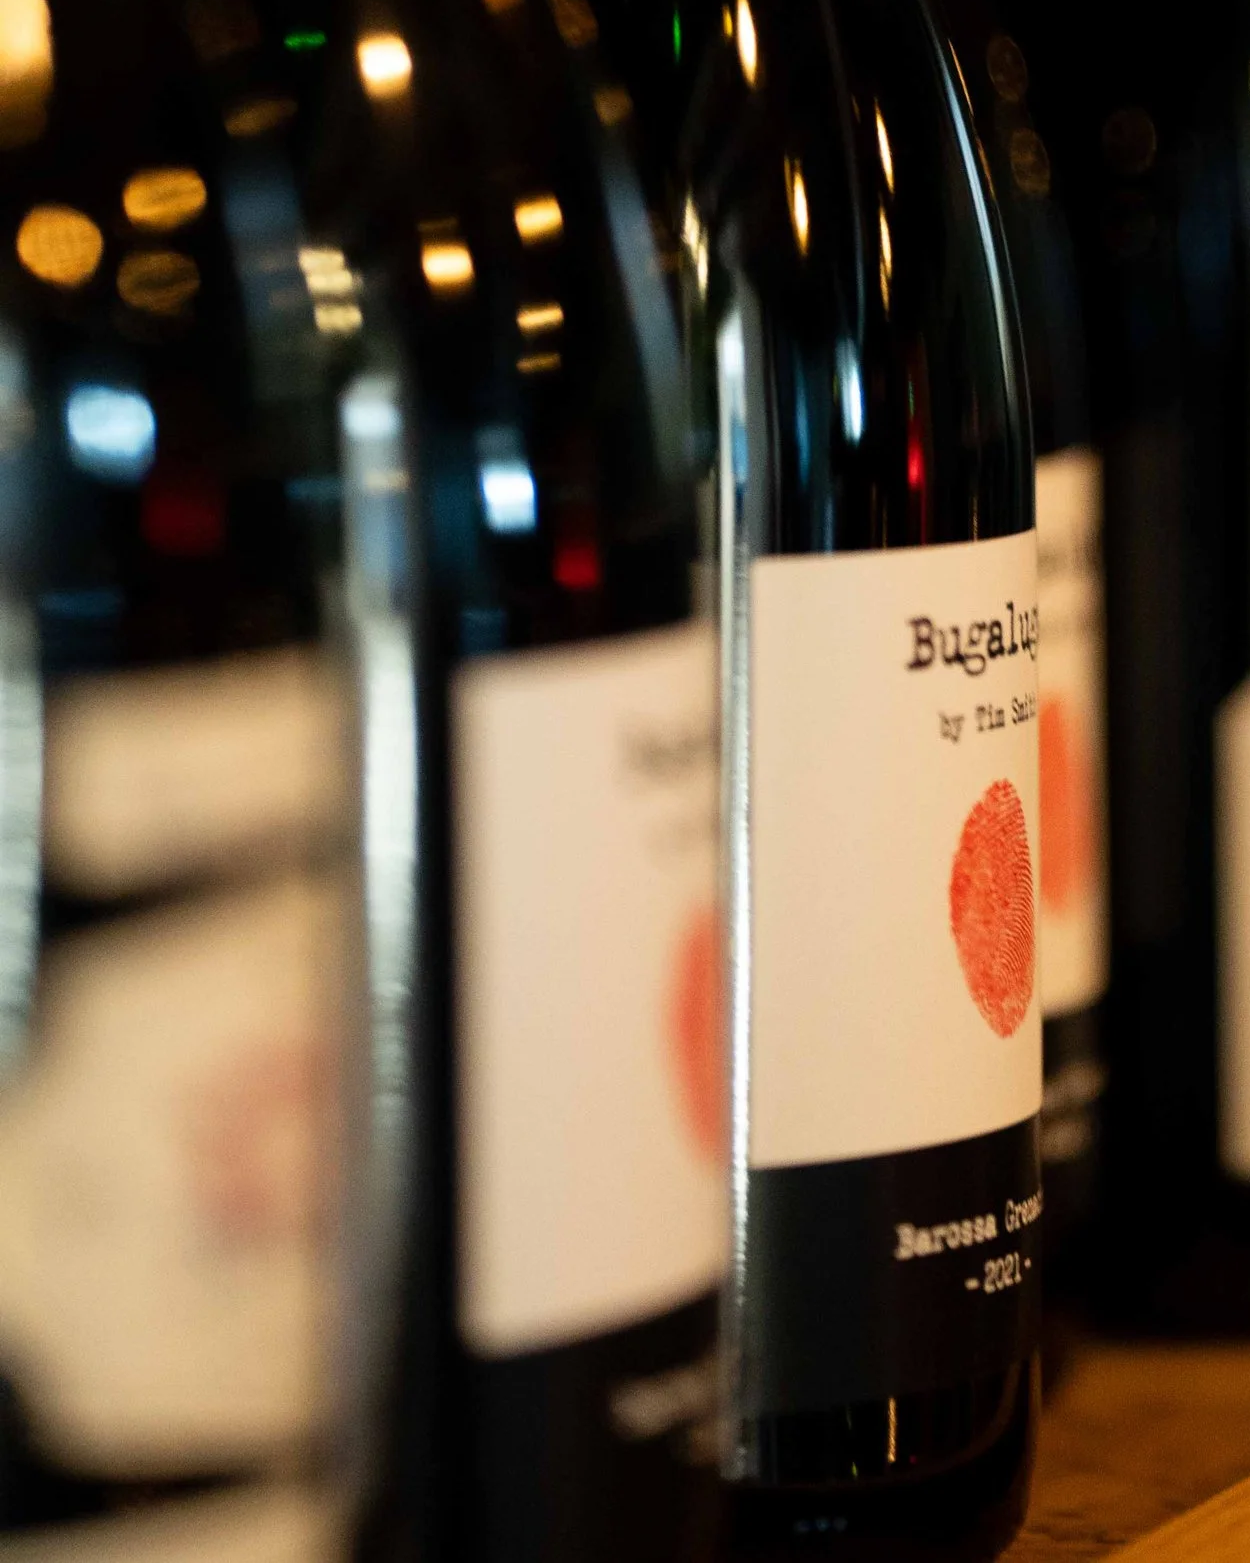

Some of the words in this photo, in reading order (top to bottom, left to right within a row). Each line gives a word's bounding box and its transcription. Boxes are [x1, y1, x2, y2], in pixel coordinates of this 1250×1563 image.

[939, 711, 964, 744] by
[976, 703, 1004, 732] Tim
[895, 1213, 997, 1261] Barossa
